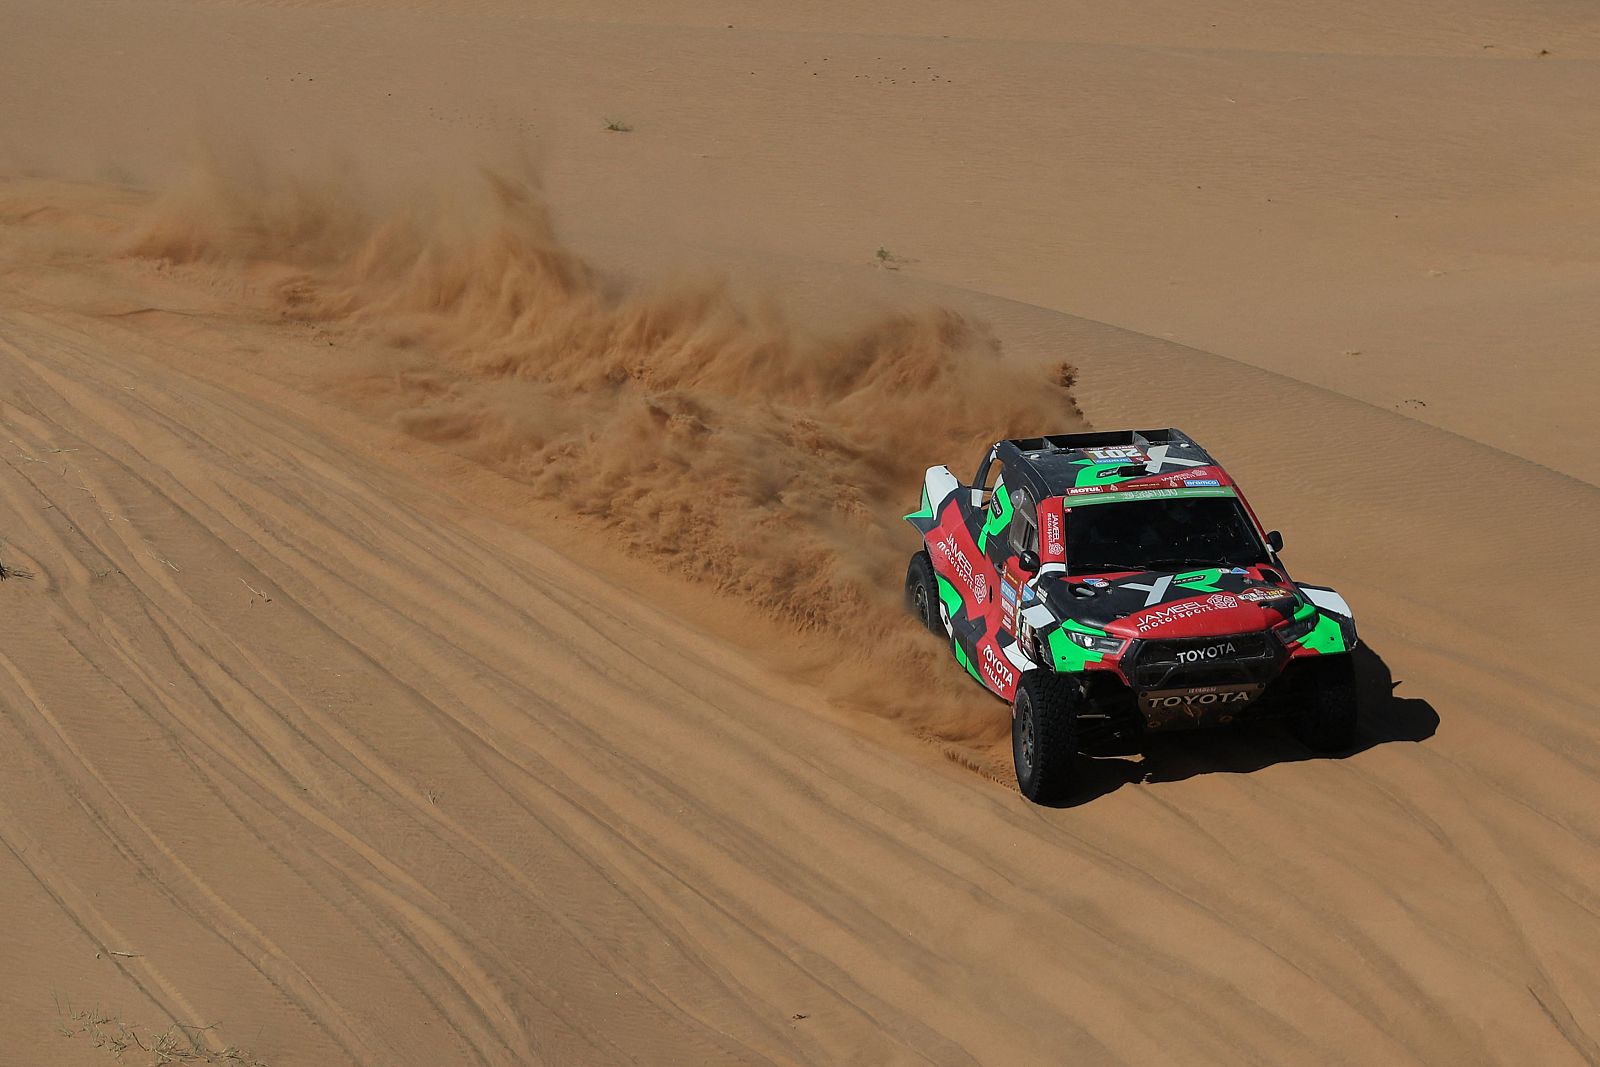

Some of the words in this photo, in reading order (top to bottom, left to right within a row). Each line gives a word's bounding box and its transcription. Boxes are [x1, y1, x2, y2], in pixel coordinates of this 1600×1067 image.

[1069, 486, 1102, 495] MOTUL
[1051, 512, 1060, 542] JAMEEL
[945, 533, 976, 584] JAMEEL
[1136, 601, 1208, 627] JAMEEL
[982, 644, 1013, 687] TOYOTA
[1176, 641, 1236, 664] TOYOTA
[983, 662, 1006, 692] HILUX
[1149, 690, 1251, 708] TOYOTA
